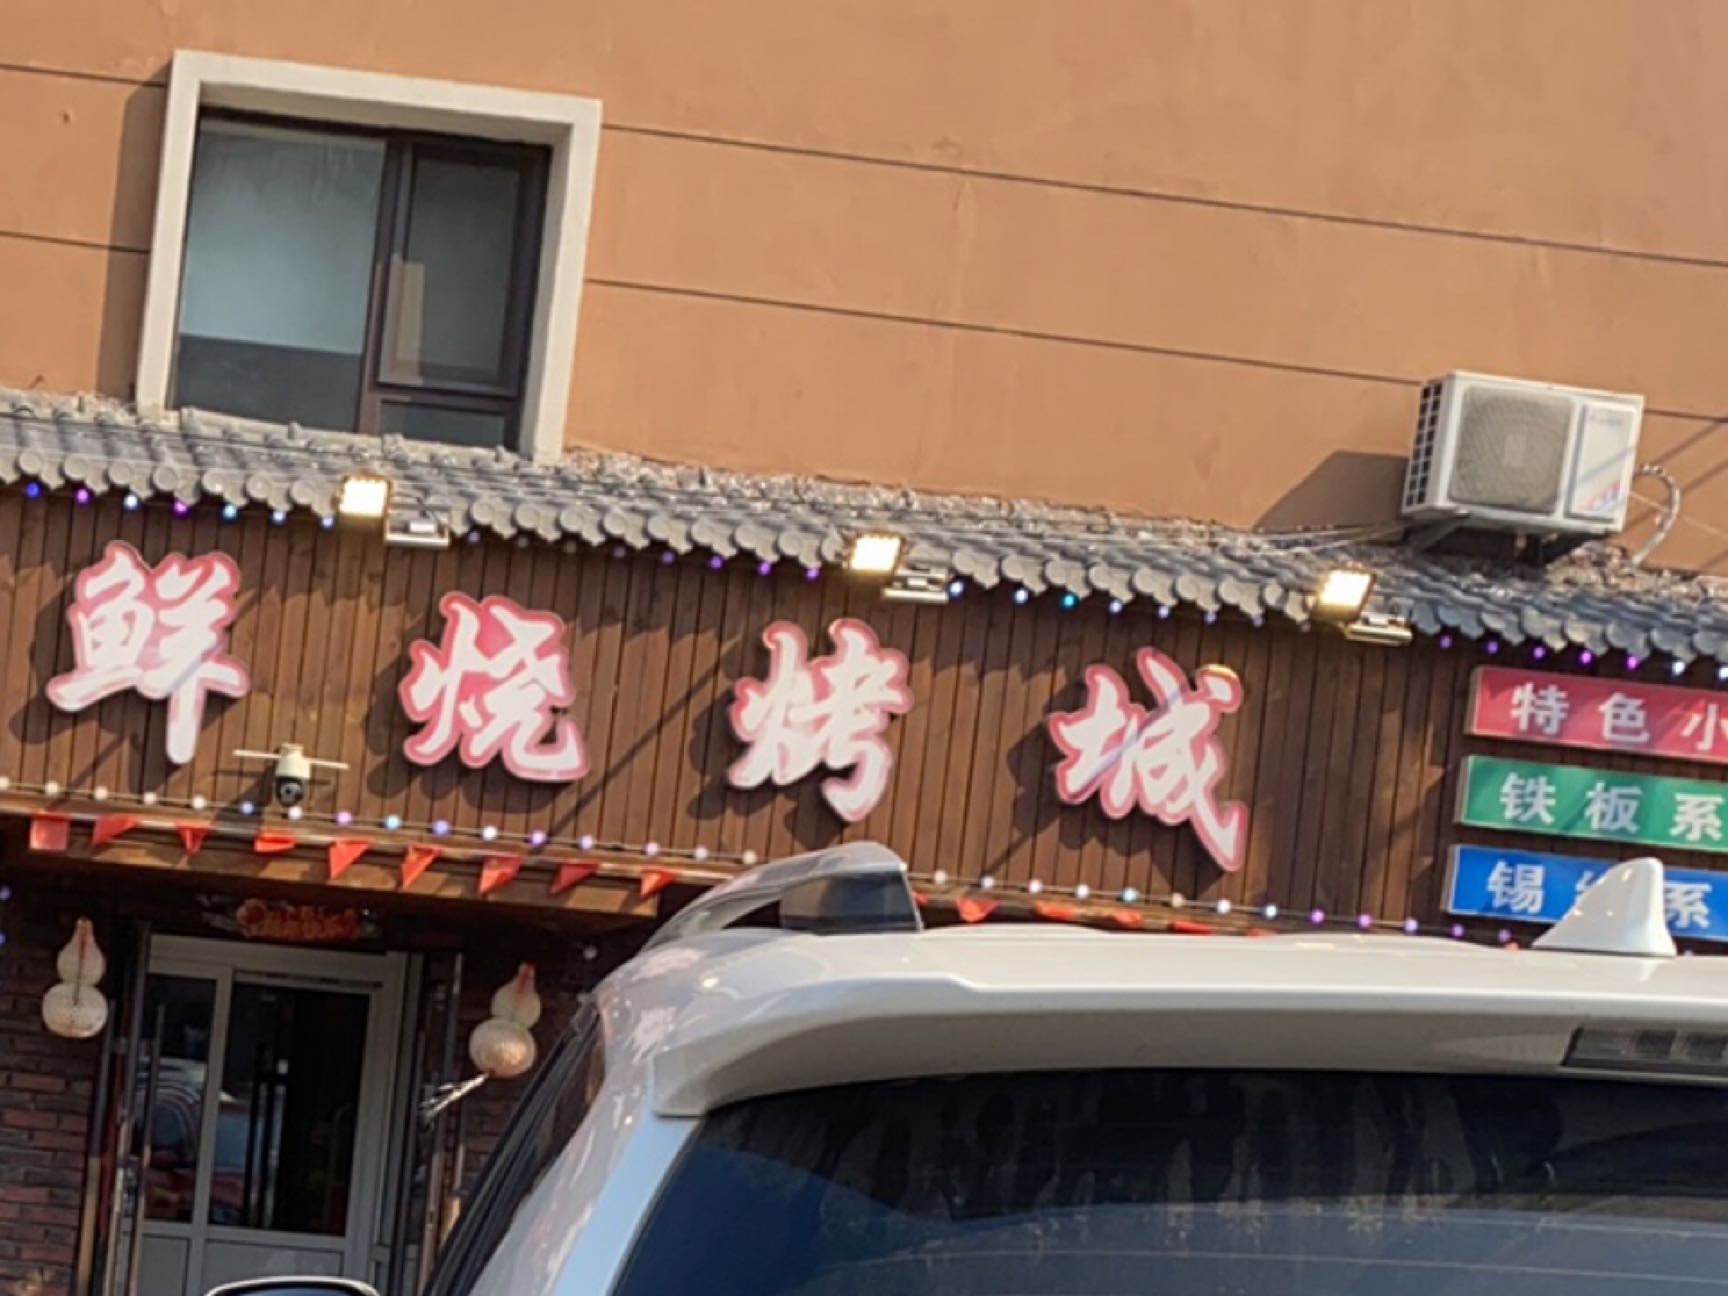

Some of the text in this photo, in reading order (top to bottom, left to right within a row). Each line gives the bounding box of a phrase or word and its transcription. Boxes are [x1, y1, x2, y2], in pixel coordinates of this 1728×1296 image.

[1509, 682, 1728, 752] 特色小
[1499, 771, 1725, 841] 铁板系
[1487, 861, 1713, 929] 锡系
